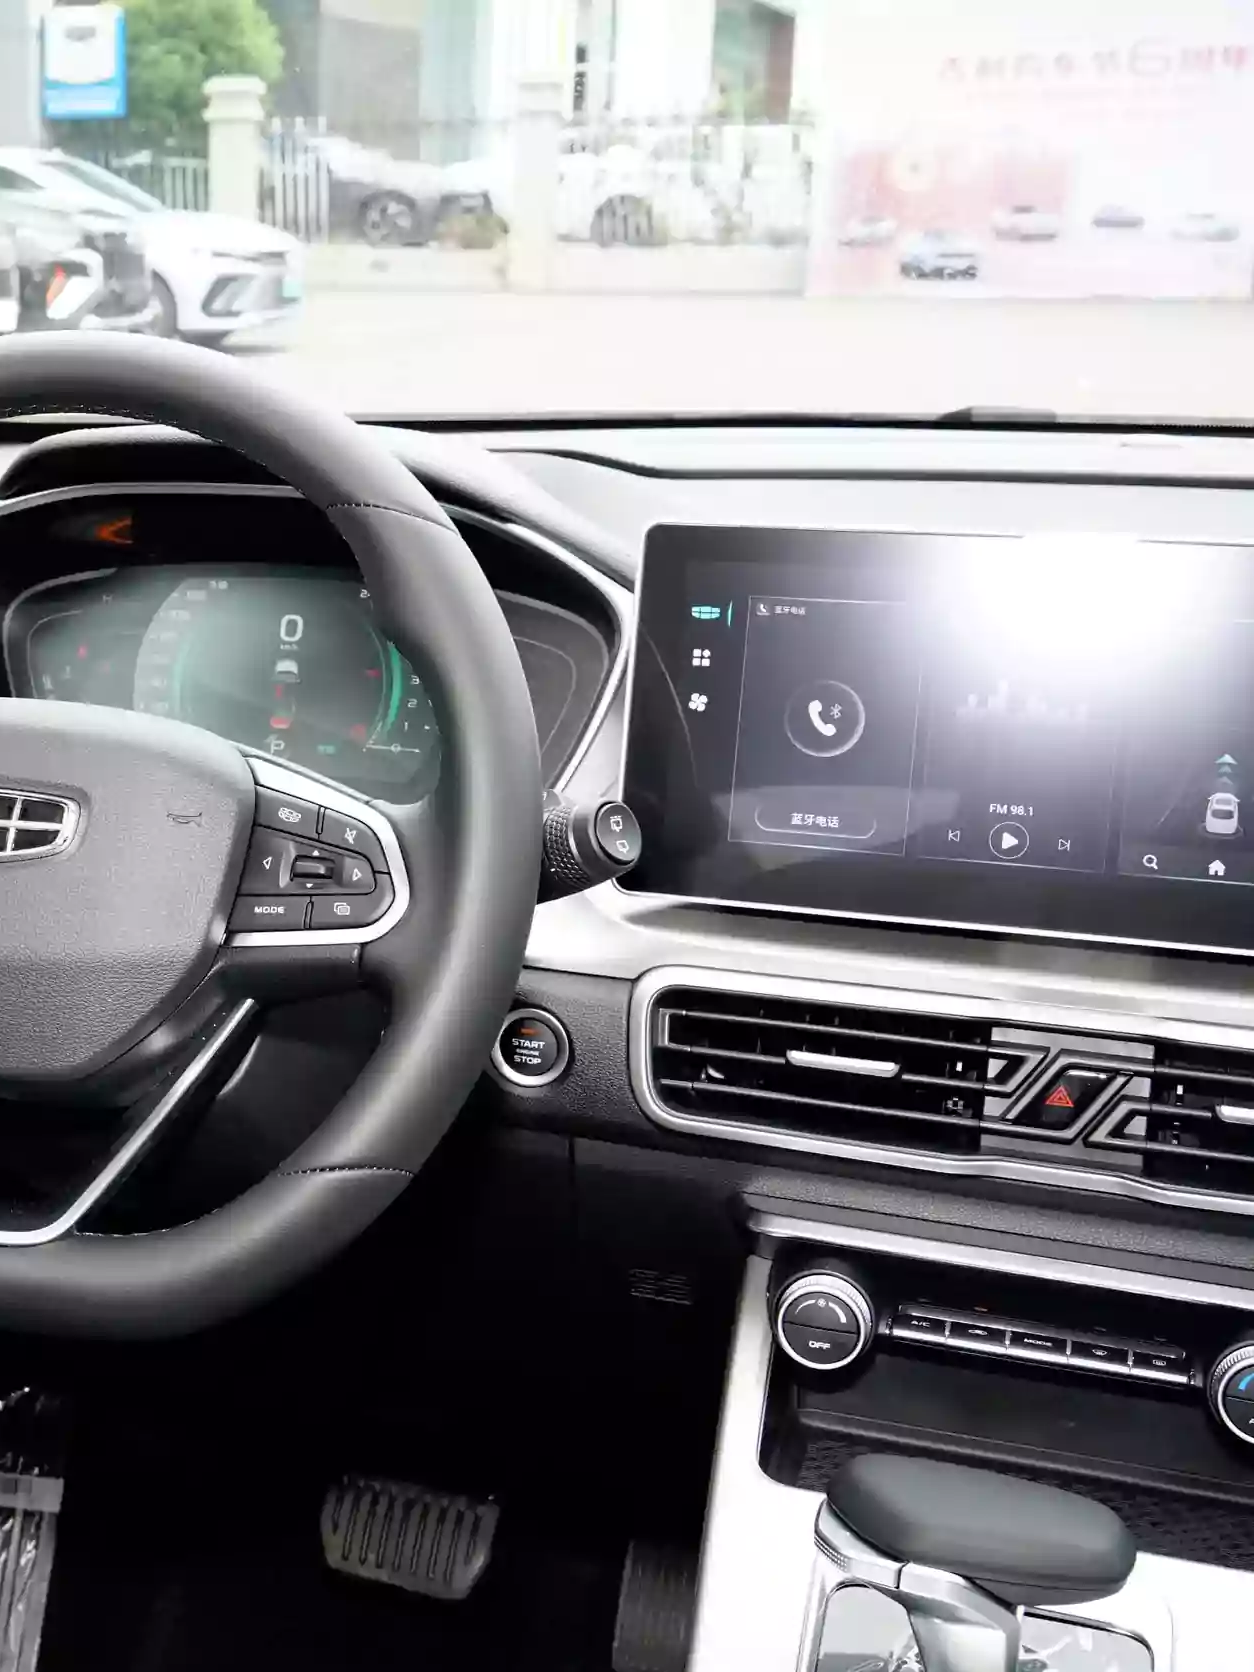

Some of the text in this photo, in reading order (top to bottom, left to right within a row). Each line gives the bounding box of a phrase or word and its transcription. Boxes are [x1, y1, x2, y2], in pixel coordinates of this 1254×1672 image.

[280, 613, 304, 643] 0
[410, 674, 420, 685] 3
[407, 698, 418, 708] 2
[989, 803, 1034, 817] FM 98.1
[790, 811, 840, 828] 蓝牙电话
[253, 905, 284, 914] MODE
[512, 1037, 546, 1050] START
[513, 1055, 543, 1065] STOP
[911, 1319, 932, 1328] A/C
[808, 1340, 831, 1350] OFF
[1023, 1338, 1053, 1347] MODE
